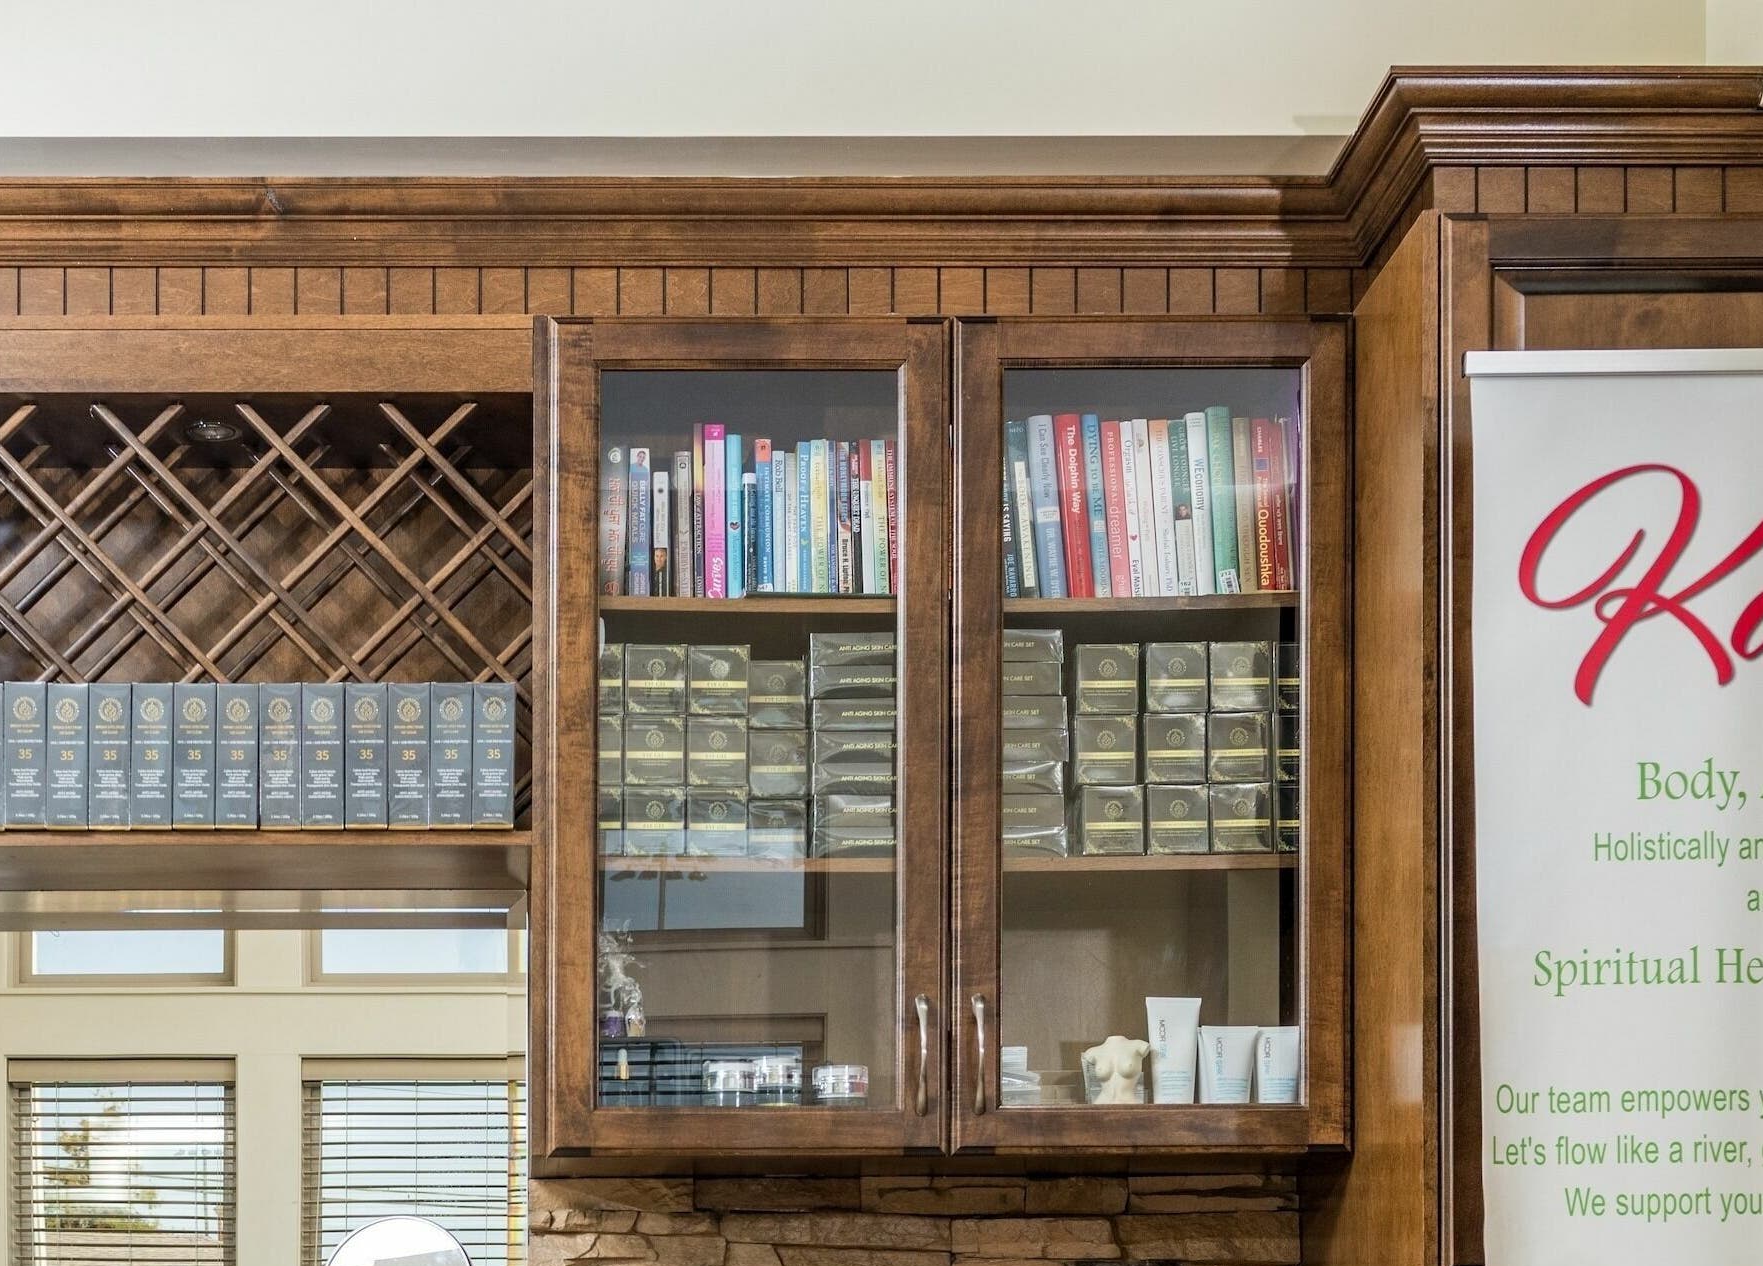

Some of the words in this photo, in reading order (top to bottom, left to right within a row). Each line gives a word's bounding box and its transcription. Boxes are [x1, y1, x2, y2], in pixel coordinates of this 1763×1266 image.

[1067, 425, 1076, 445] The
[1087, 425, 1099, 464] DYING
[775, 459, 783, 476] Rob
[1068, 448, 1078, 489] Dolphin
[1107, 431, 1117, 504] PROFESSIONAL
[1193, 457, 1207, 511] WEconomy
[638, 480, 646, 505] BELLY
[775, 477, 783, 492] Bell
[638, 507, 646, 521] FAT
[1071, 491, 1081, 514] Way
[1109, 506, 1122, 559] dreamer
[1257, 509, 1273, 586] Quodoushka
[878, 537, 887, 569] POWER
[17, 749, 33, 760] 35
[60, 750, 75, 761] 35
[144, 750, 159, 761] 35
[187, 750, 202, 761] 35
[273, 750, 288, 761] 35
[1636, 757, 1747, 810] Body,
[1594, 830, 1729, 867] Holistically
[1534, 945, 1701, 997] Spiritual
[1496, 1084, 1539, 1114] Our
[1549, 1086, 1610, 1113] team
[1621, 1088, 1750, 1118] empowers
[1493, 1135, 1546, 1165] Let's
[1556, 1135, 1606, 1164] flow
[1617, 1135, 1658, 1163] like
[1669, 1140, 1682, 1163] a
[1694, 1134, 1751, 1168] river,
[1565, 1187, 1605, 1216] We
[1616, 1187, 1711, 1222] support
